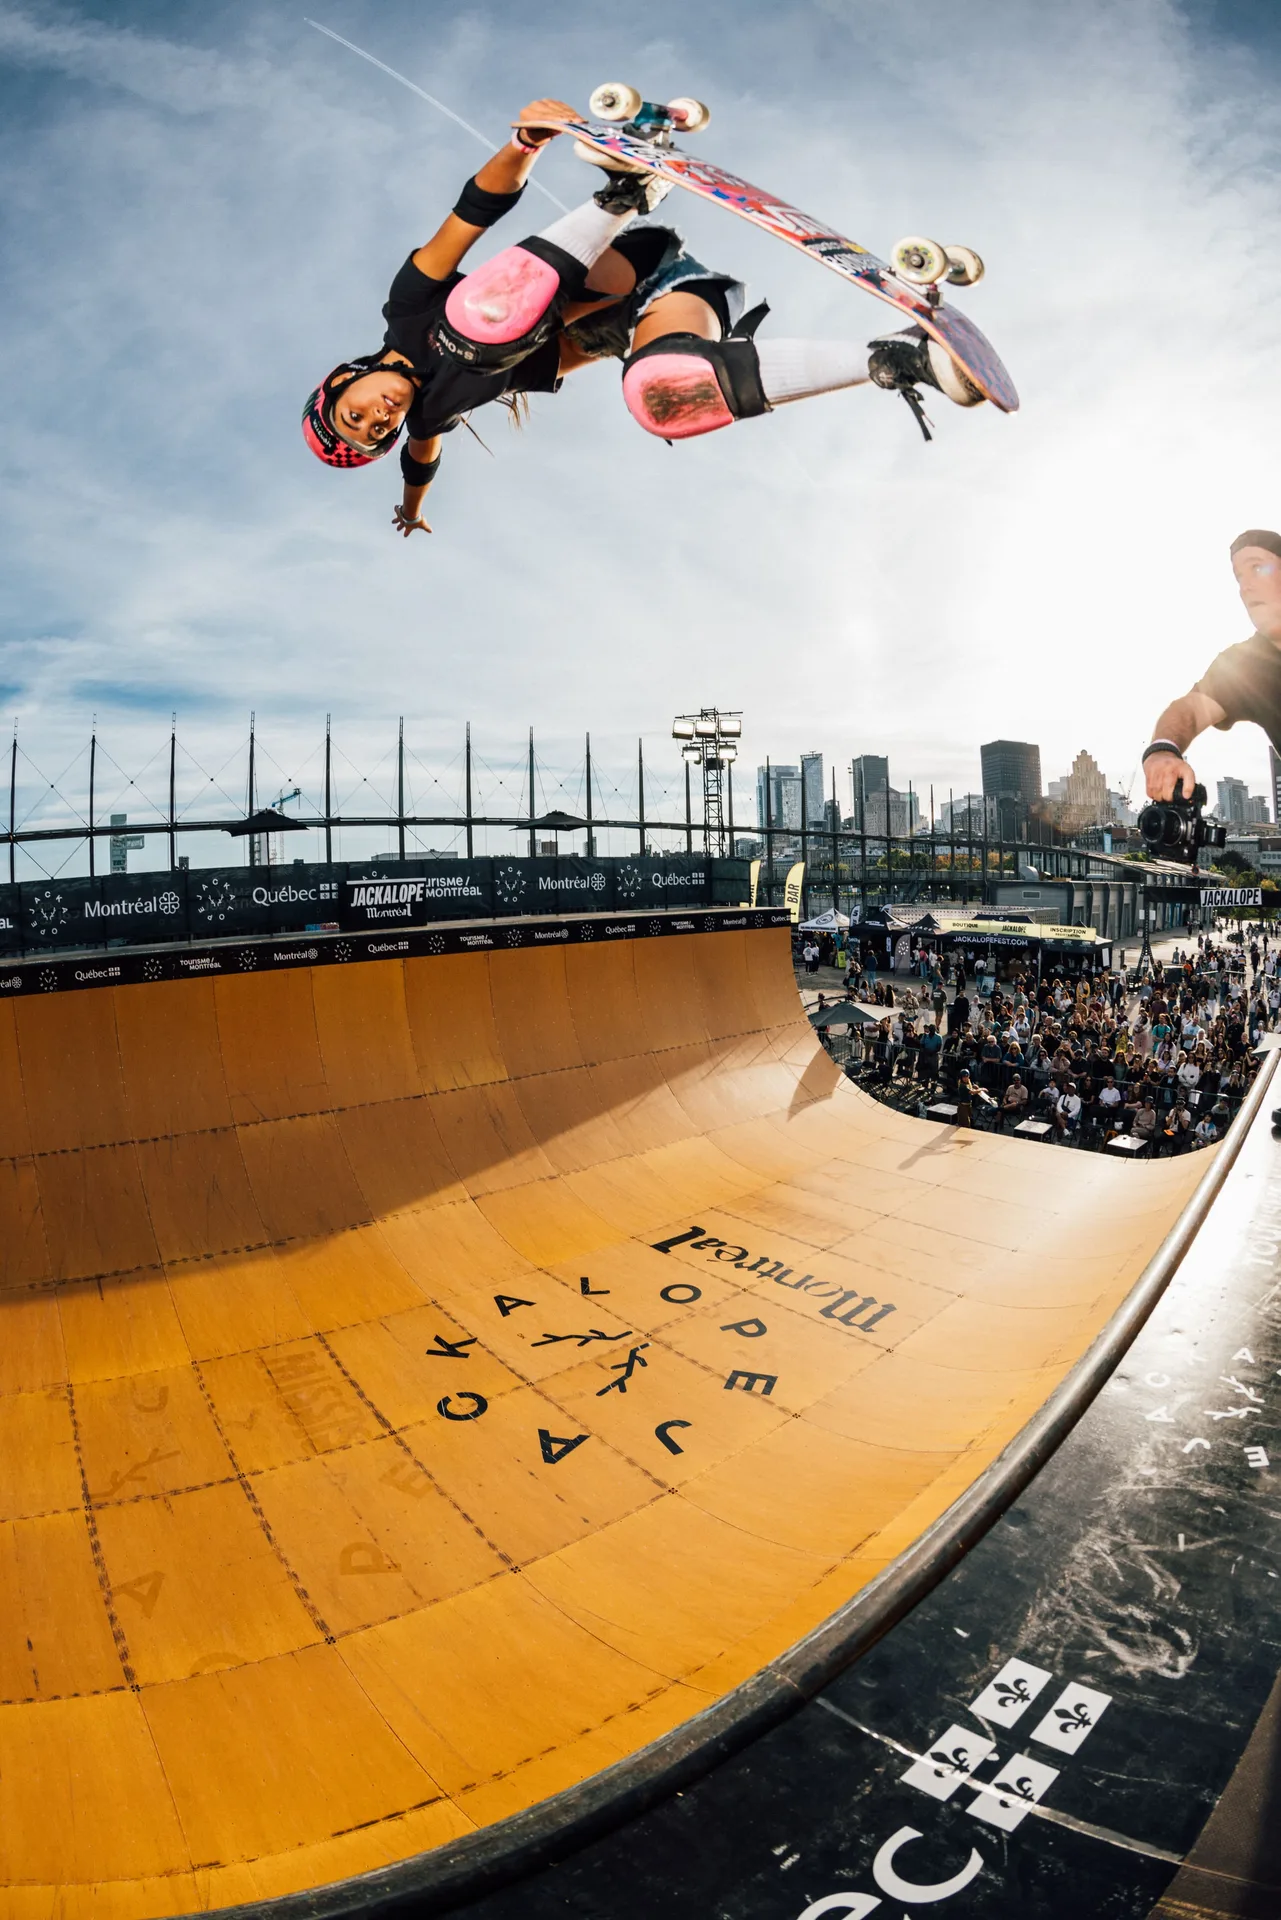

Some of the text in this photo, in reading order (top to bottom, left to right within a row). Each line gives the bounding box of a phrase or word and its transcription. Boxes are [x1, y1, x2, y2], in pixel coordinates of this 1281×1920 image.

[539, 876, 590, 890] Montréal
[652, 873, 691, 888] Québec
[252, 885, 318, 907] Québec
[350, 883, 425, 907] JACKALOPE
[786, 883, 800, 904] BAR
[1202, 888, 1260, 906] JACKALOPE
[84, 895, 157, 918] Montréal
[366, 903, 412, 919] Montréal
[1050, 927, 1087, 935] INSCRIPTION
[368, 941, 398, 953] Québec
[953, 935, 1028, 946] JACKALOPEFEST.COM
[273, 948, 308, 961] Montréal
[75, 969, 107, 981] Québec
[650, 1225, 897, 1333] Montréal
